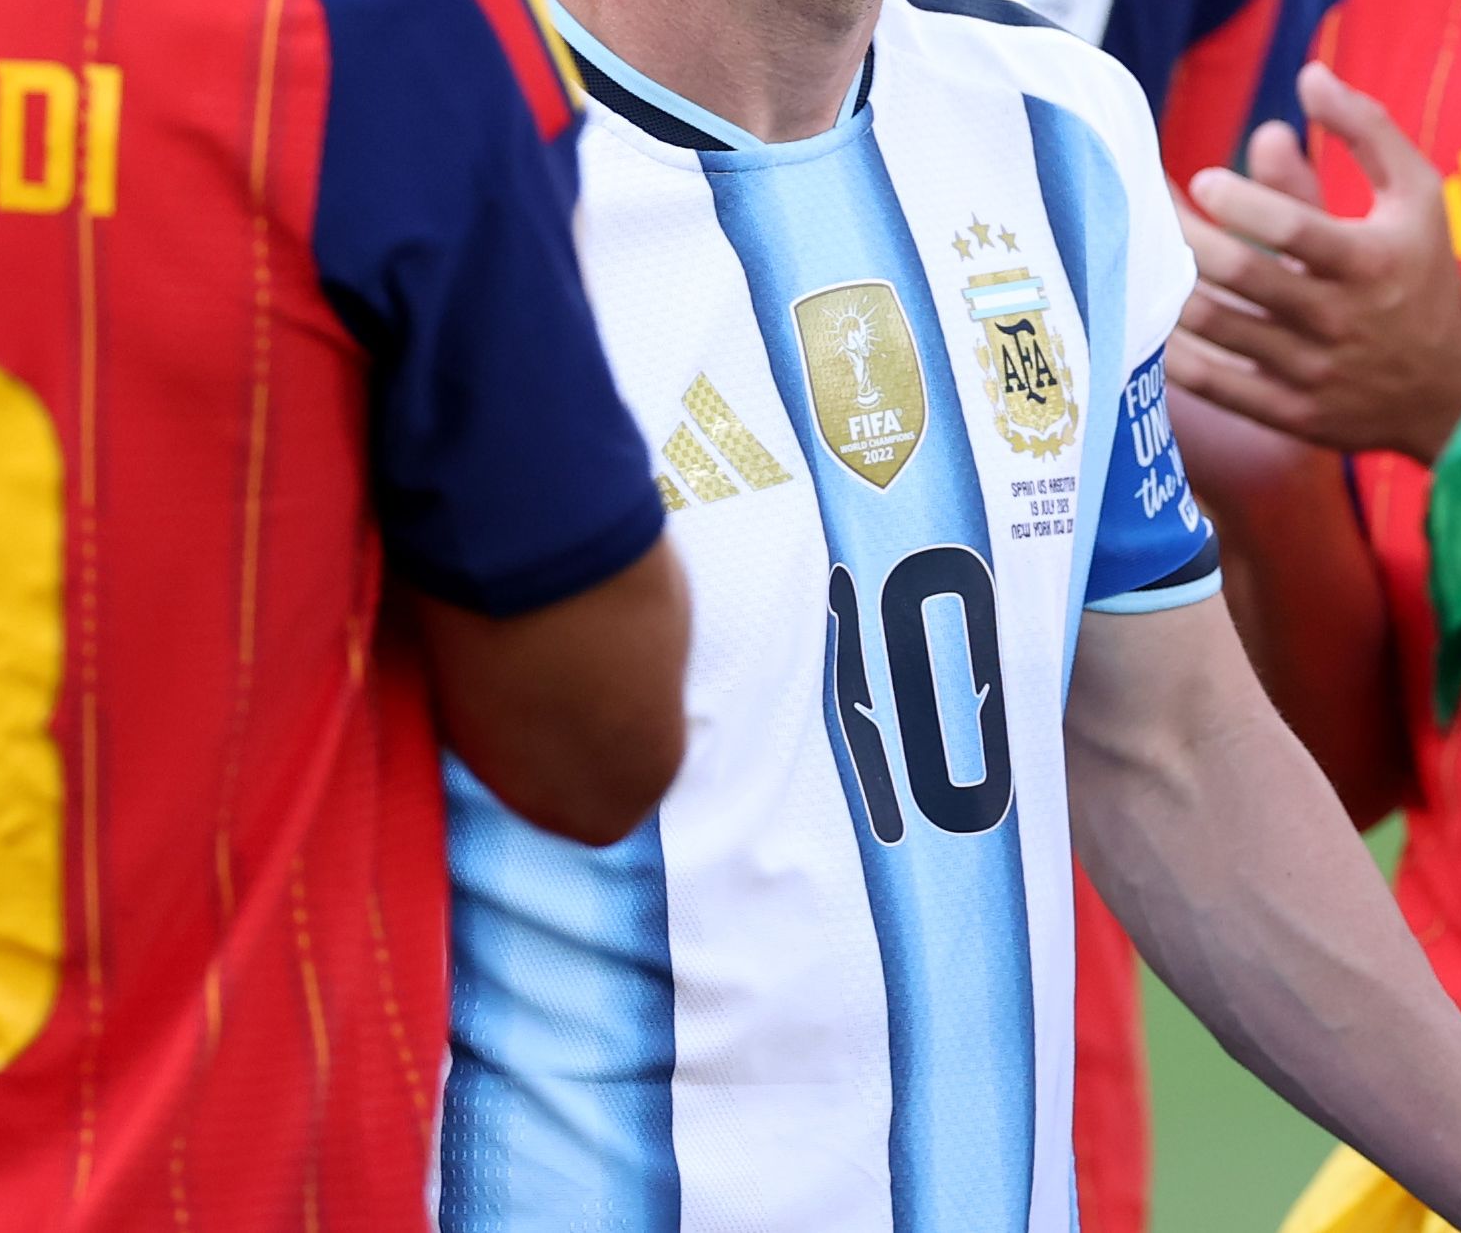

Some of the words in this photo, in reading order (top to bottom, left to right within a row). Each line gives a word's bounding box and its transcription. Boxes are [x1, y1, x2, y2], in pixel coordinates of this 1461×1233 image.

[994, 318, 1058, 404] AFA
[848, 409, 902, 441] FIFA
[862, 446, 895, 465] 2022
[1135, 467, 1177, 519] the
[827, 546, 1016, 846] 10
